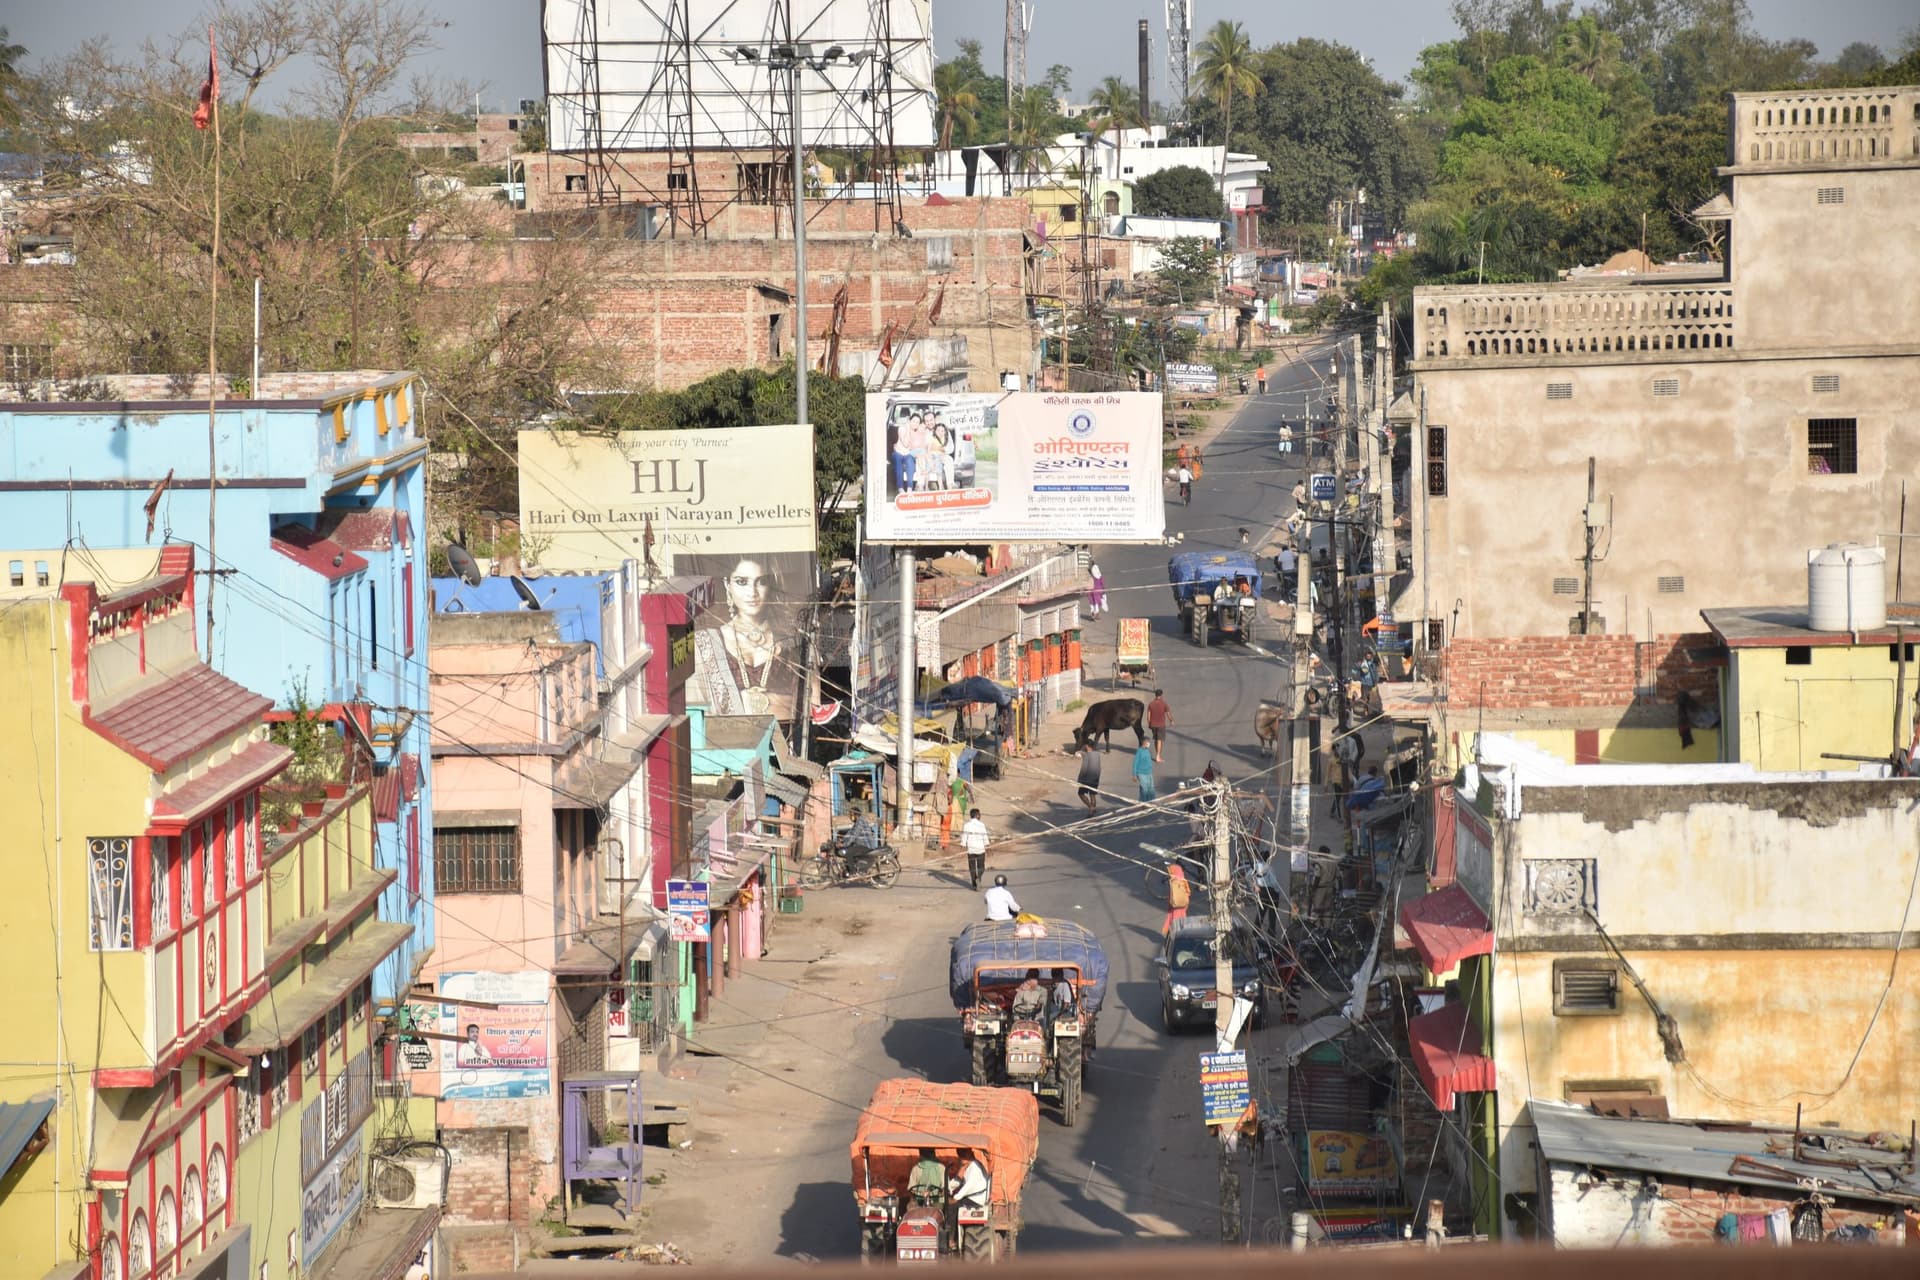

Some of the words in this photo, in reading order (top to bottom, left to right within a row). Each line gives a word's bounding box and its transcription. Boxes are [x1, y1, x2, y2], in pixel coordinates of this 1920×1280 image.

[1166, 363, 1187, 371] BLUE
[631, 438, 642, 448] in
[644, 438, 667, 450] your
[669, 436, 688, 449] city
[1034, 437, 1130, 456] ओरिएण्टल
[630, 458, 708, 505] HLJ
[1314, 478, 1335, 488] ATM
[529, 509, 566, 525] Hari
[572, 509, 602, 524] Om
[608, 506, 660, 523] Laxmi
[666, 506, 733, 525] Narayan
[737, 504, 811, 525] Jewellers
[509, 1028, 525, 1037] कुमार
